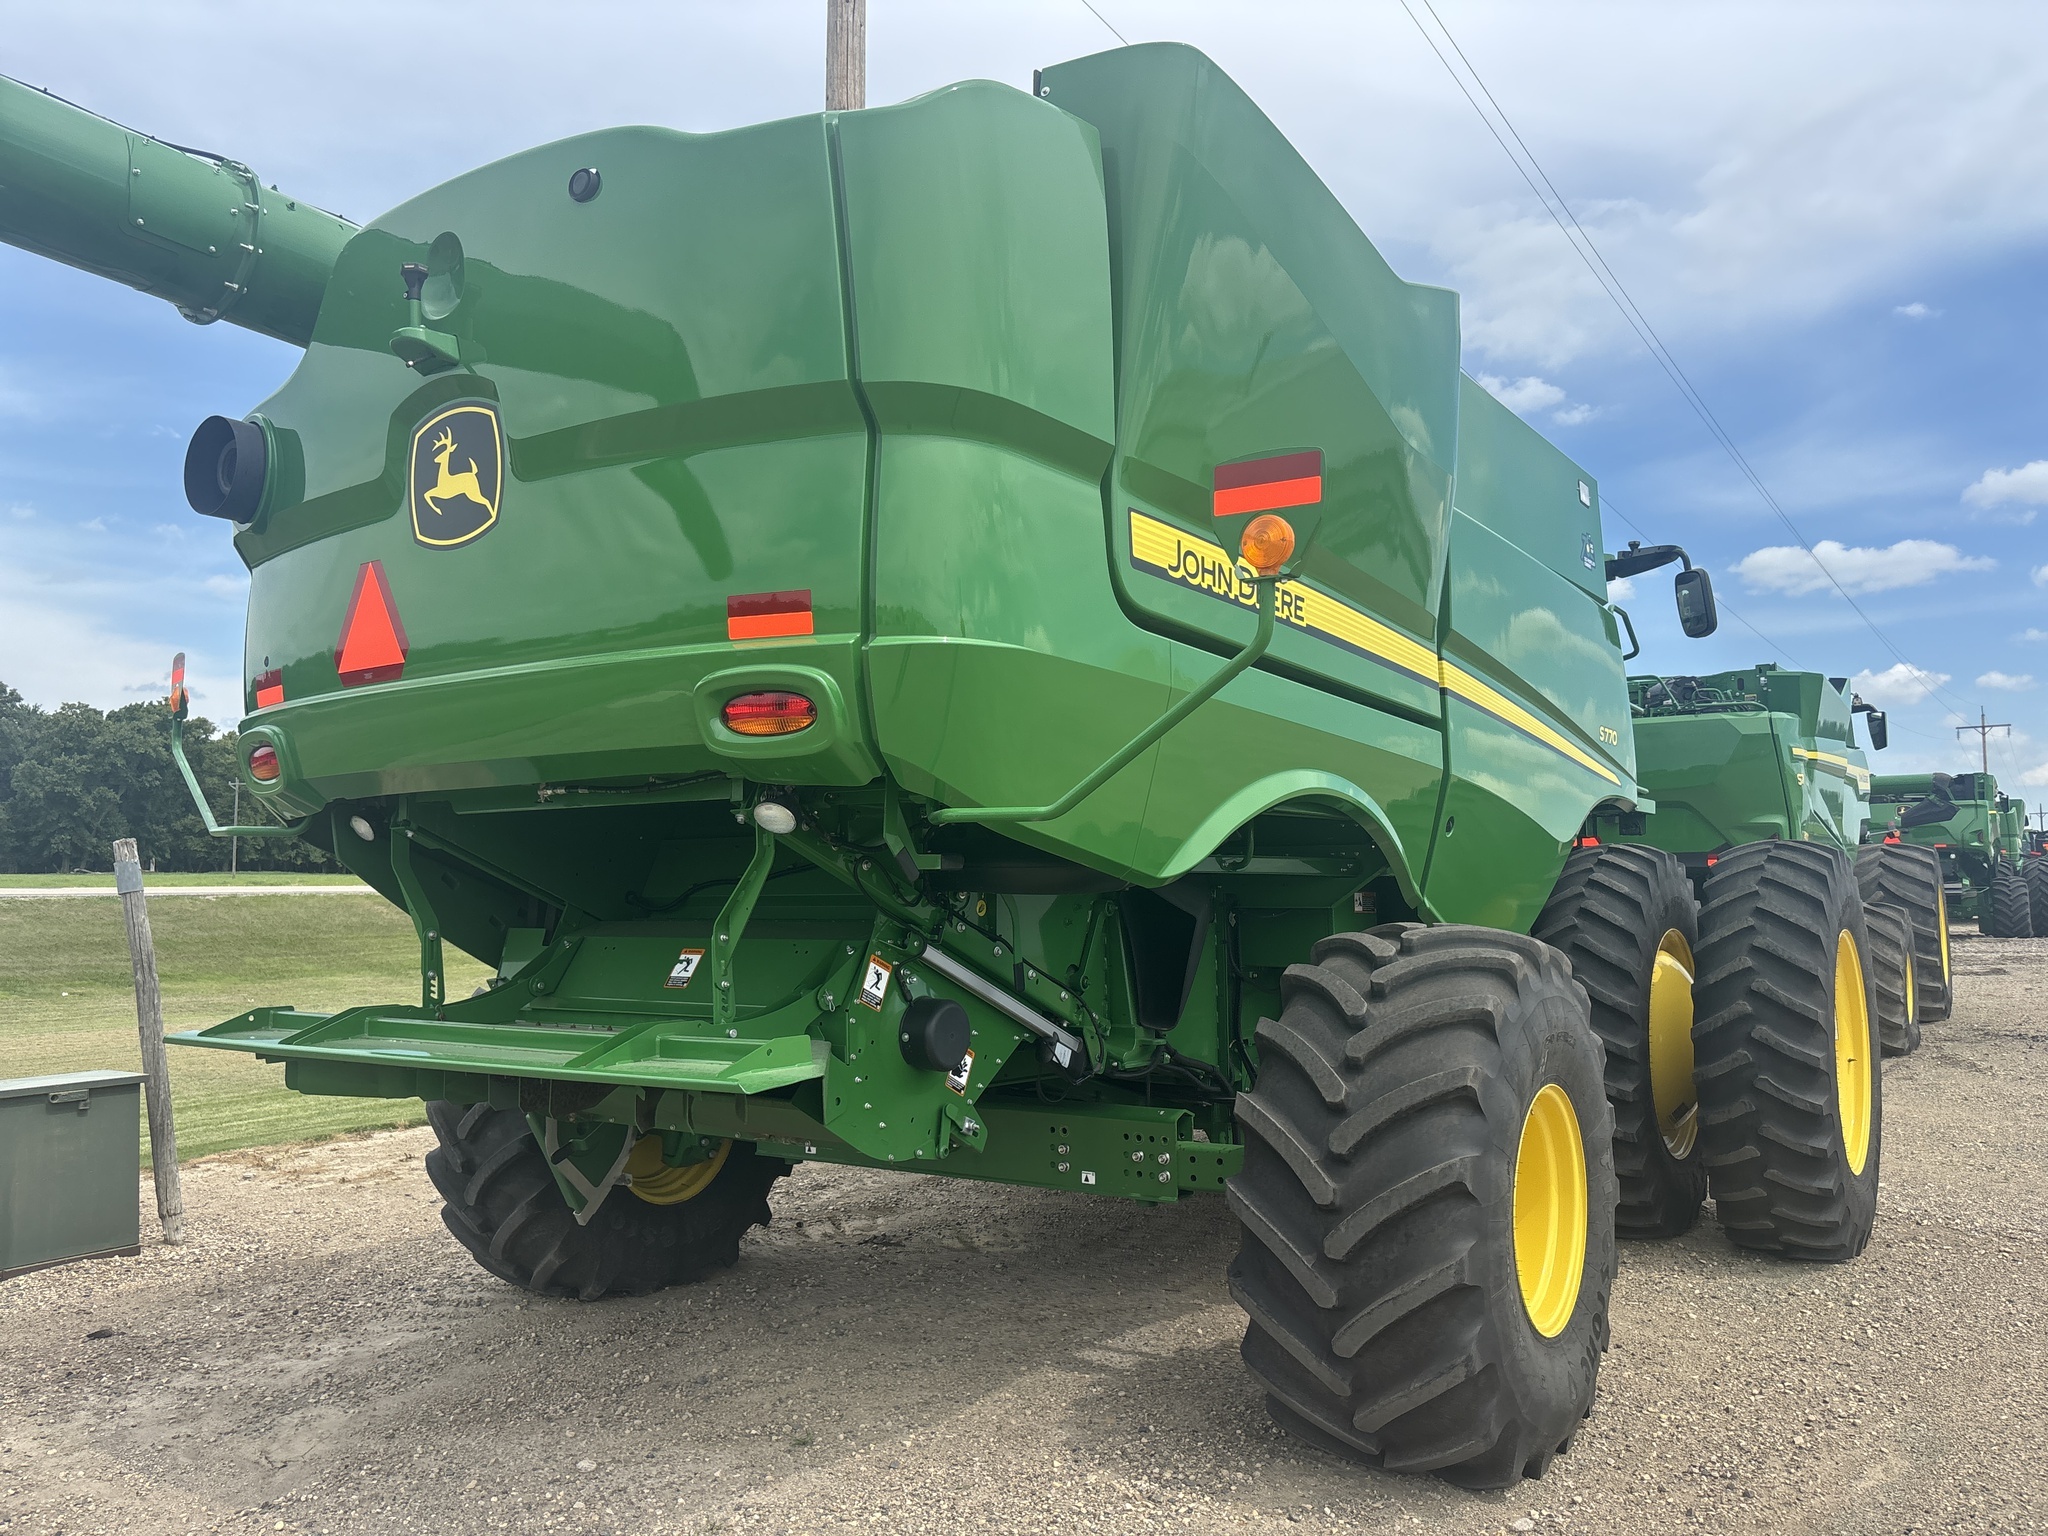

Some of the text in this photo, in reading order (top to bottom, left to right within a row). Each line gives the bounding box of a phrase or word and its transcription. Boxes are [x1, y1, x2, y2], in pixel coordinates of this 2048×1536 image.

[1167, 539, 1305, 623] JOHN DRE
[1599, 725, 1618, 746] S770
